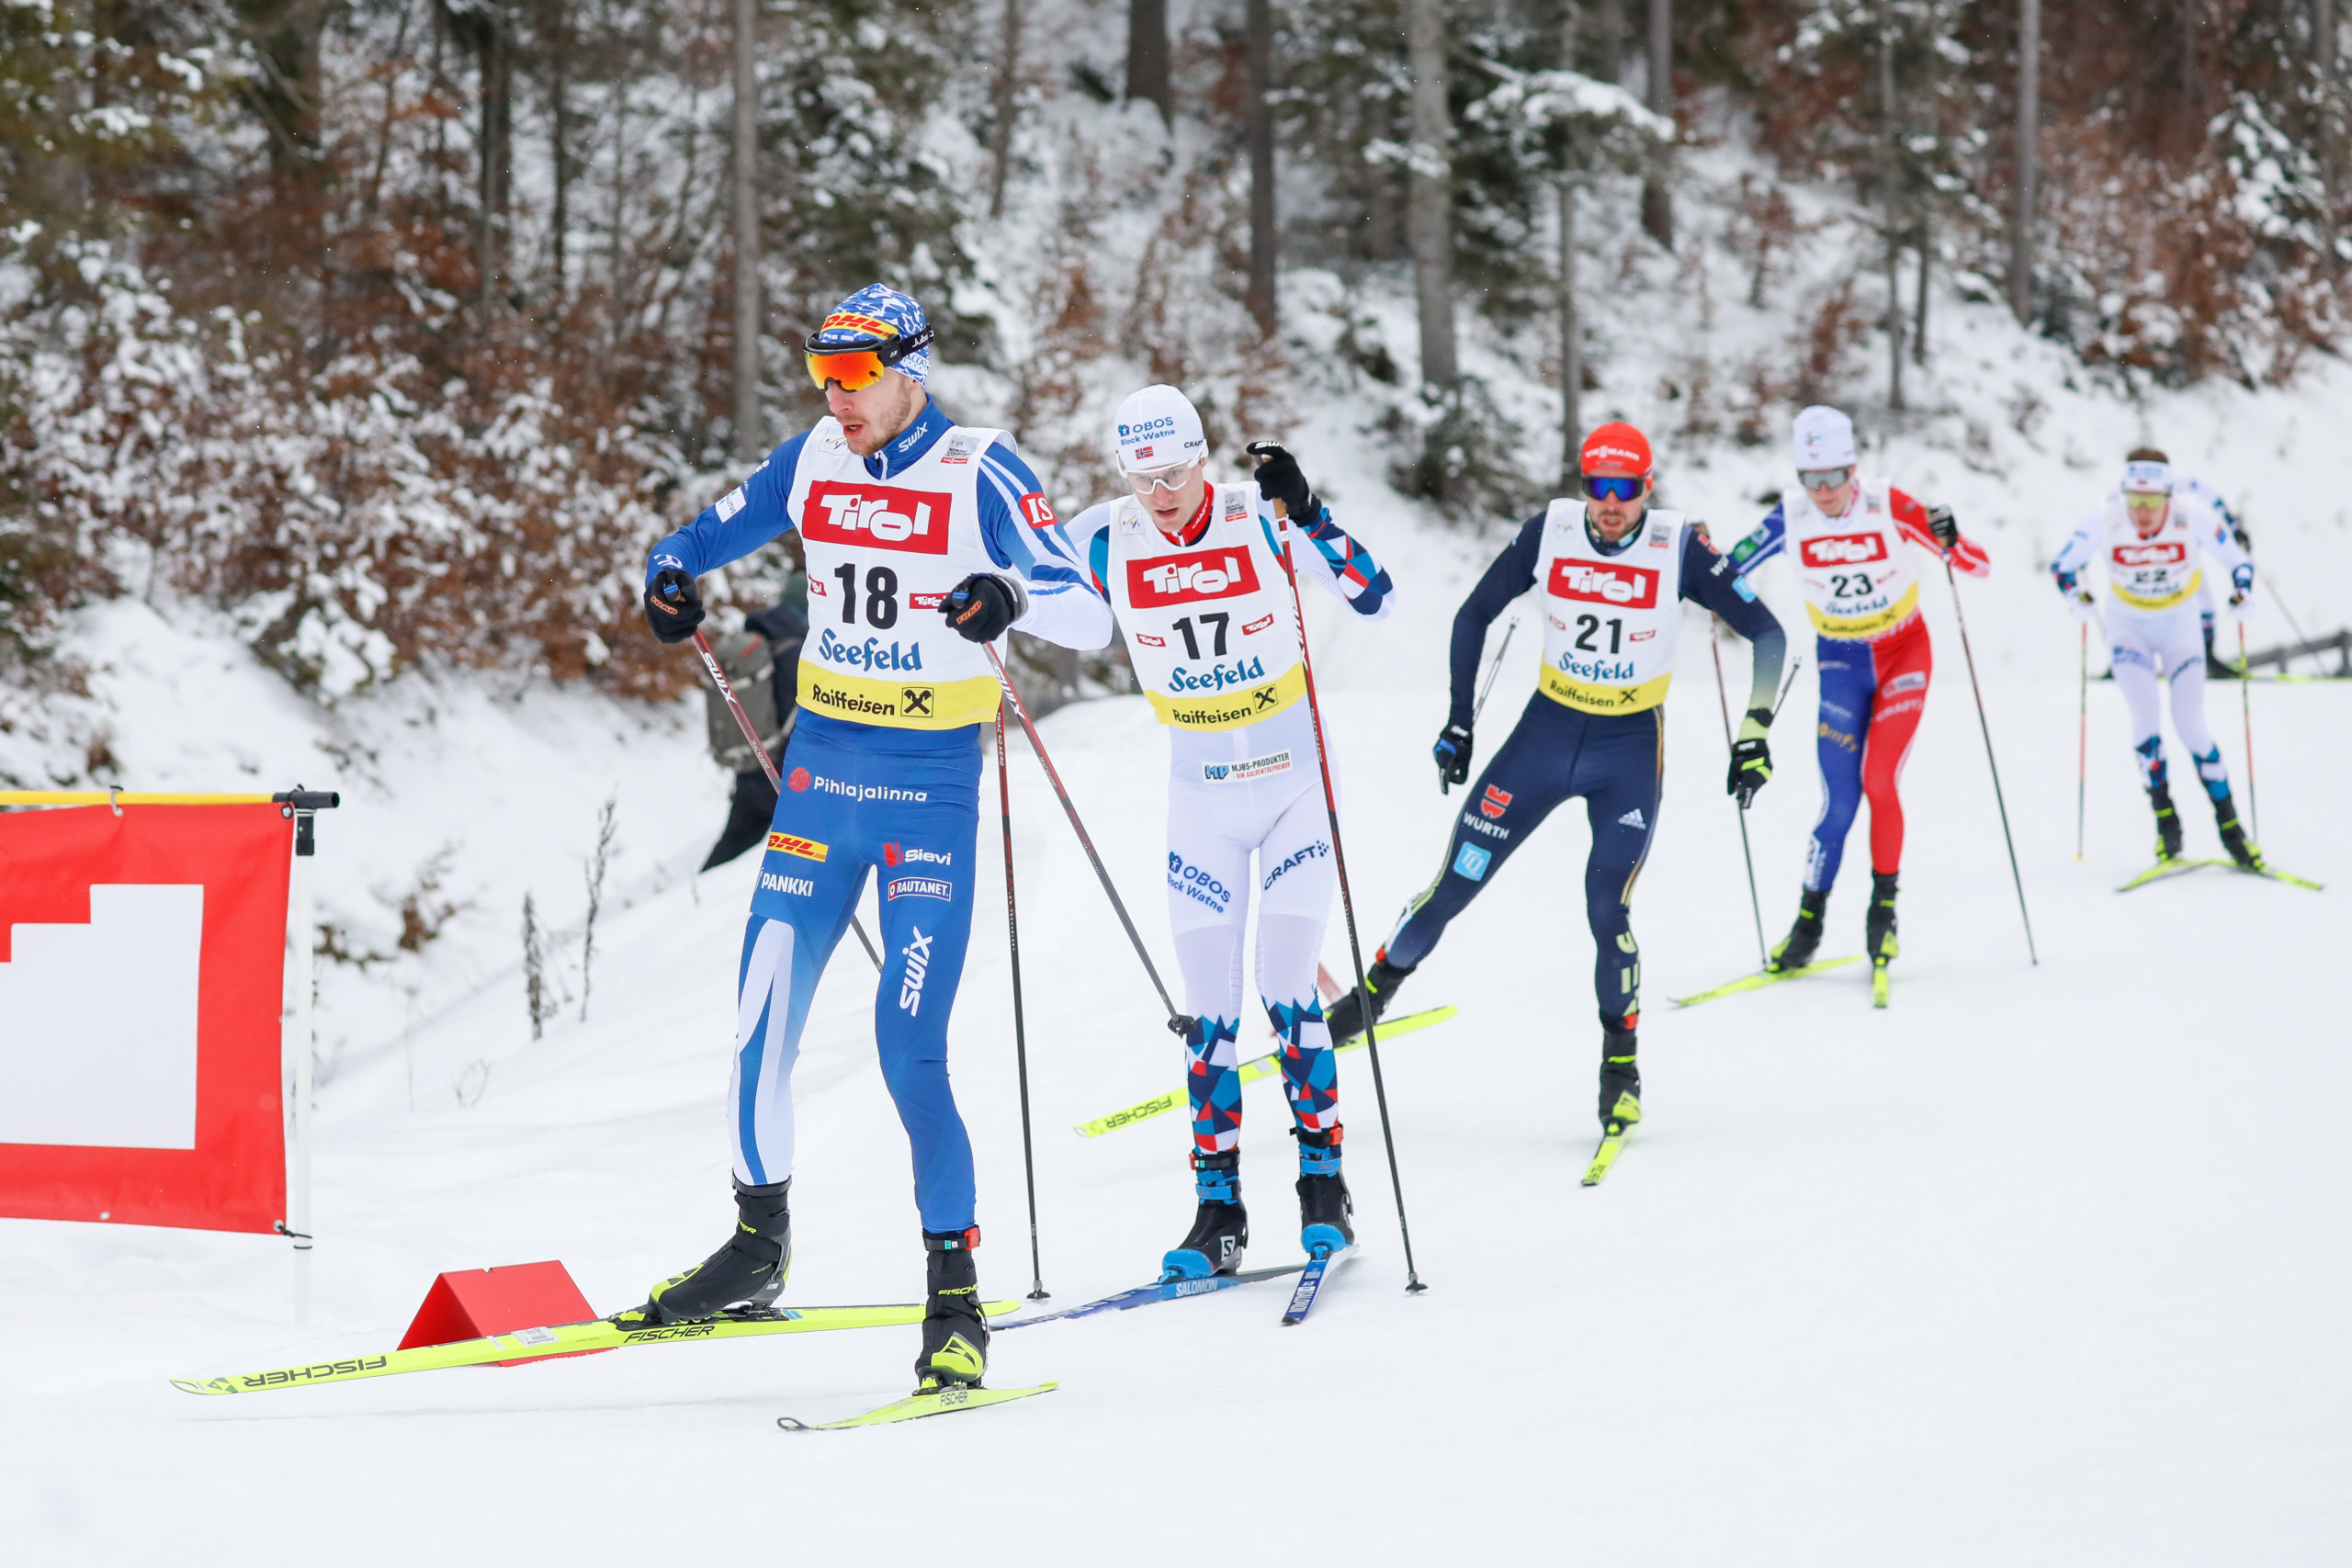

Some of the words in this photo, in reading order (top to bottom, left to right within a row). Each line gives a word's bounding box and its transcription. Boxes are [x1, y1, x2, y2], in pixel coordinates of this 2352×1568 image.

[822, 315, 883, 334] DHL
[1121, 437, 1141, 446] Block
[1143, 429, 1176, 441] Watne
[1133, 417, 1174, 434] OBOS
[820, 494, 932, 542] Tirol
[1808, 536, 1878, 562] Tirol
[1143, 557, 1241, 593] Tirol
[1561, 566, 1646, 603] Tirol
[1831, 573, 1872, 597] 23
[834, 563, 899, 629] 18
[1172, 612, 1229, 660] 17
[1575, 615, 1623, 654] 21
[818, 628, 922, 671] Seefeld
[1169, 656, 1265, 692] Seefeld
[1559, 651, 1634, 682] Seefeld
[813, 684, 895, 715] Raiffeisen
[1549, 680, 1614, 707] Raiffeisen
[1172, 707, 1251, 724] Raiffeisen
[1231, 752, 1290, 772] MJØS-PRODUKTER
[814, 776, 928, 802] Pihlajalinna
[768, 835, 814, 856] DHL
[904, 849, 952, 865] Sievi
[1264, 845, 1316, 891] CRAFT
[1183, 865, 1231, 903] OBOS
[1187, 886, 1224, 913] Watne
[1104, 1095, 1172, 1128] FISCHER
[1176, 1279, 1217, 1297] SALOMON
[624, 1326, 715, 1343] FISCHER
[242, 1356, 388, 1387] FISCHER
[941, 1392, 968, 1407] FISCHER
